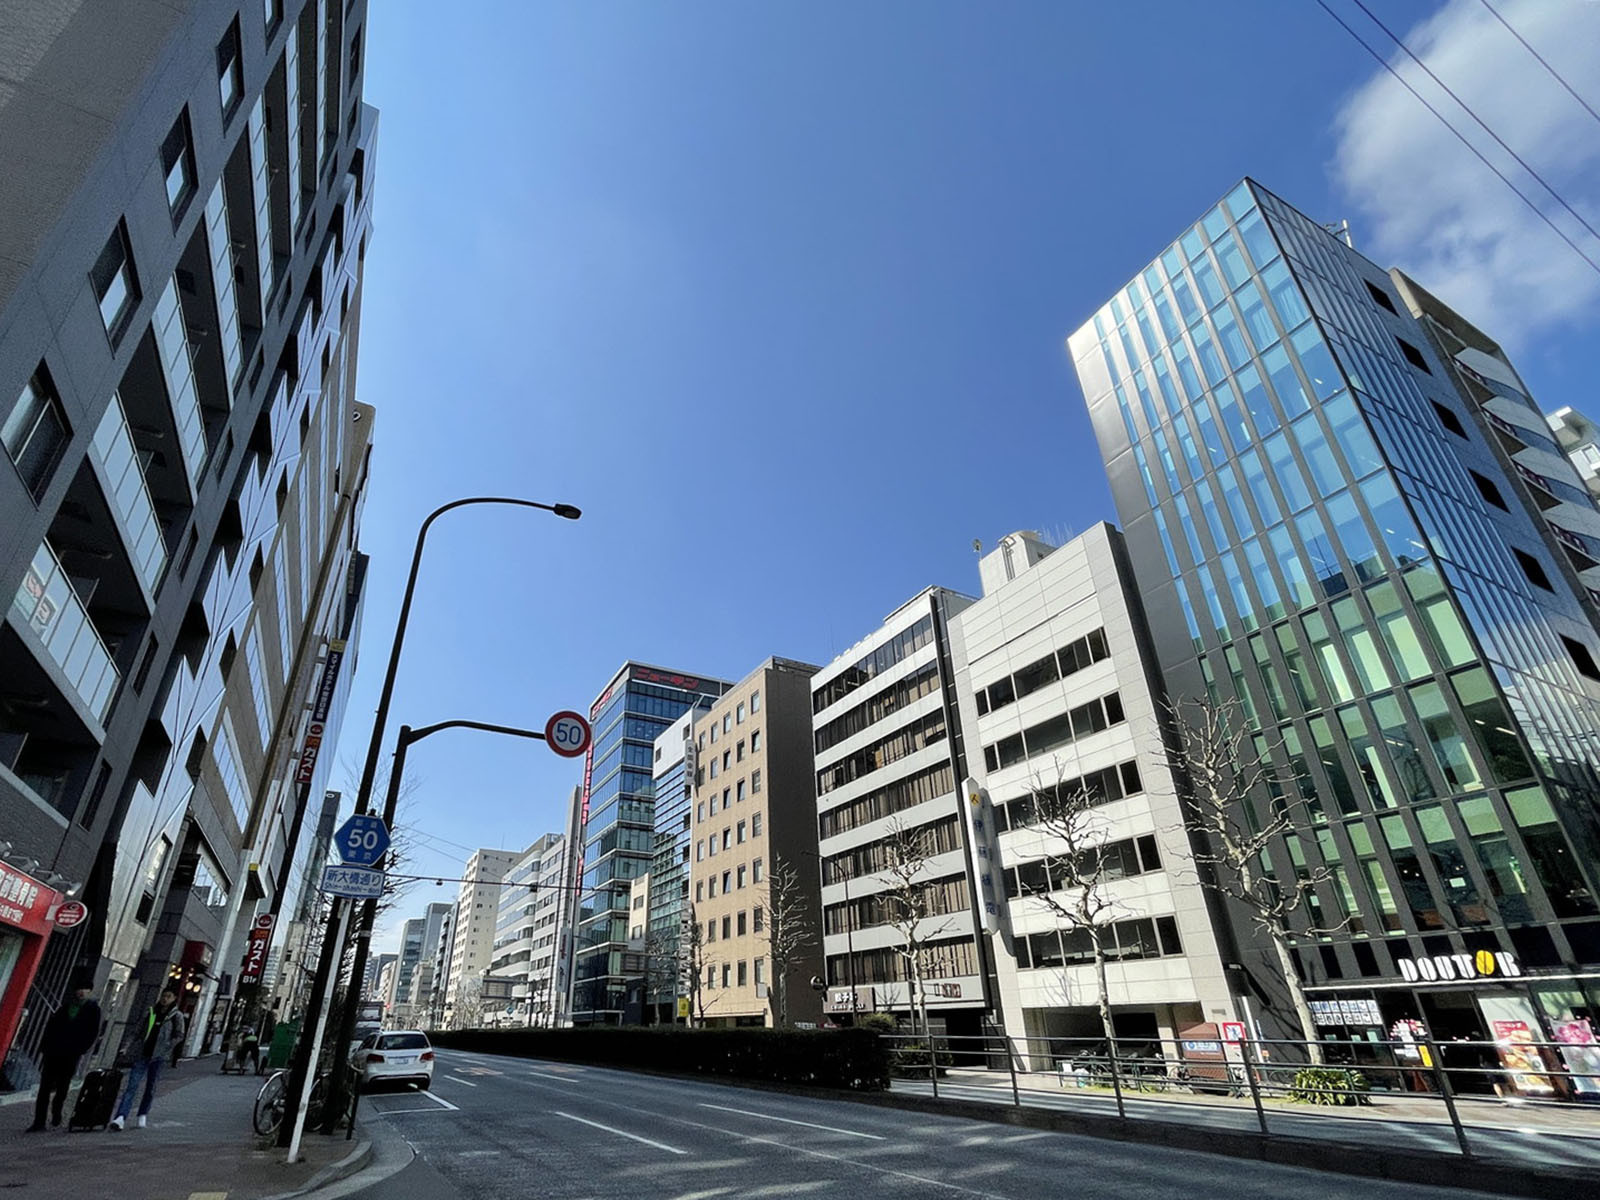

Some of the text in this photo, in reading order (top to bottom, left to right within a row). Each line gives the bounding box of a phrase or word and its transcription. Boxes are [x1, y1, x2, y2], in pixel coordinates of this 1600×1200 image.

[556, 722, 581, 745] 50
[347, 829, 379, 850] 50
[326, 869, 380, 887] 新大橋通り
[248, 939, 265, 972] ガスト
[1397, 949, 1521, 982] DOUTOR
